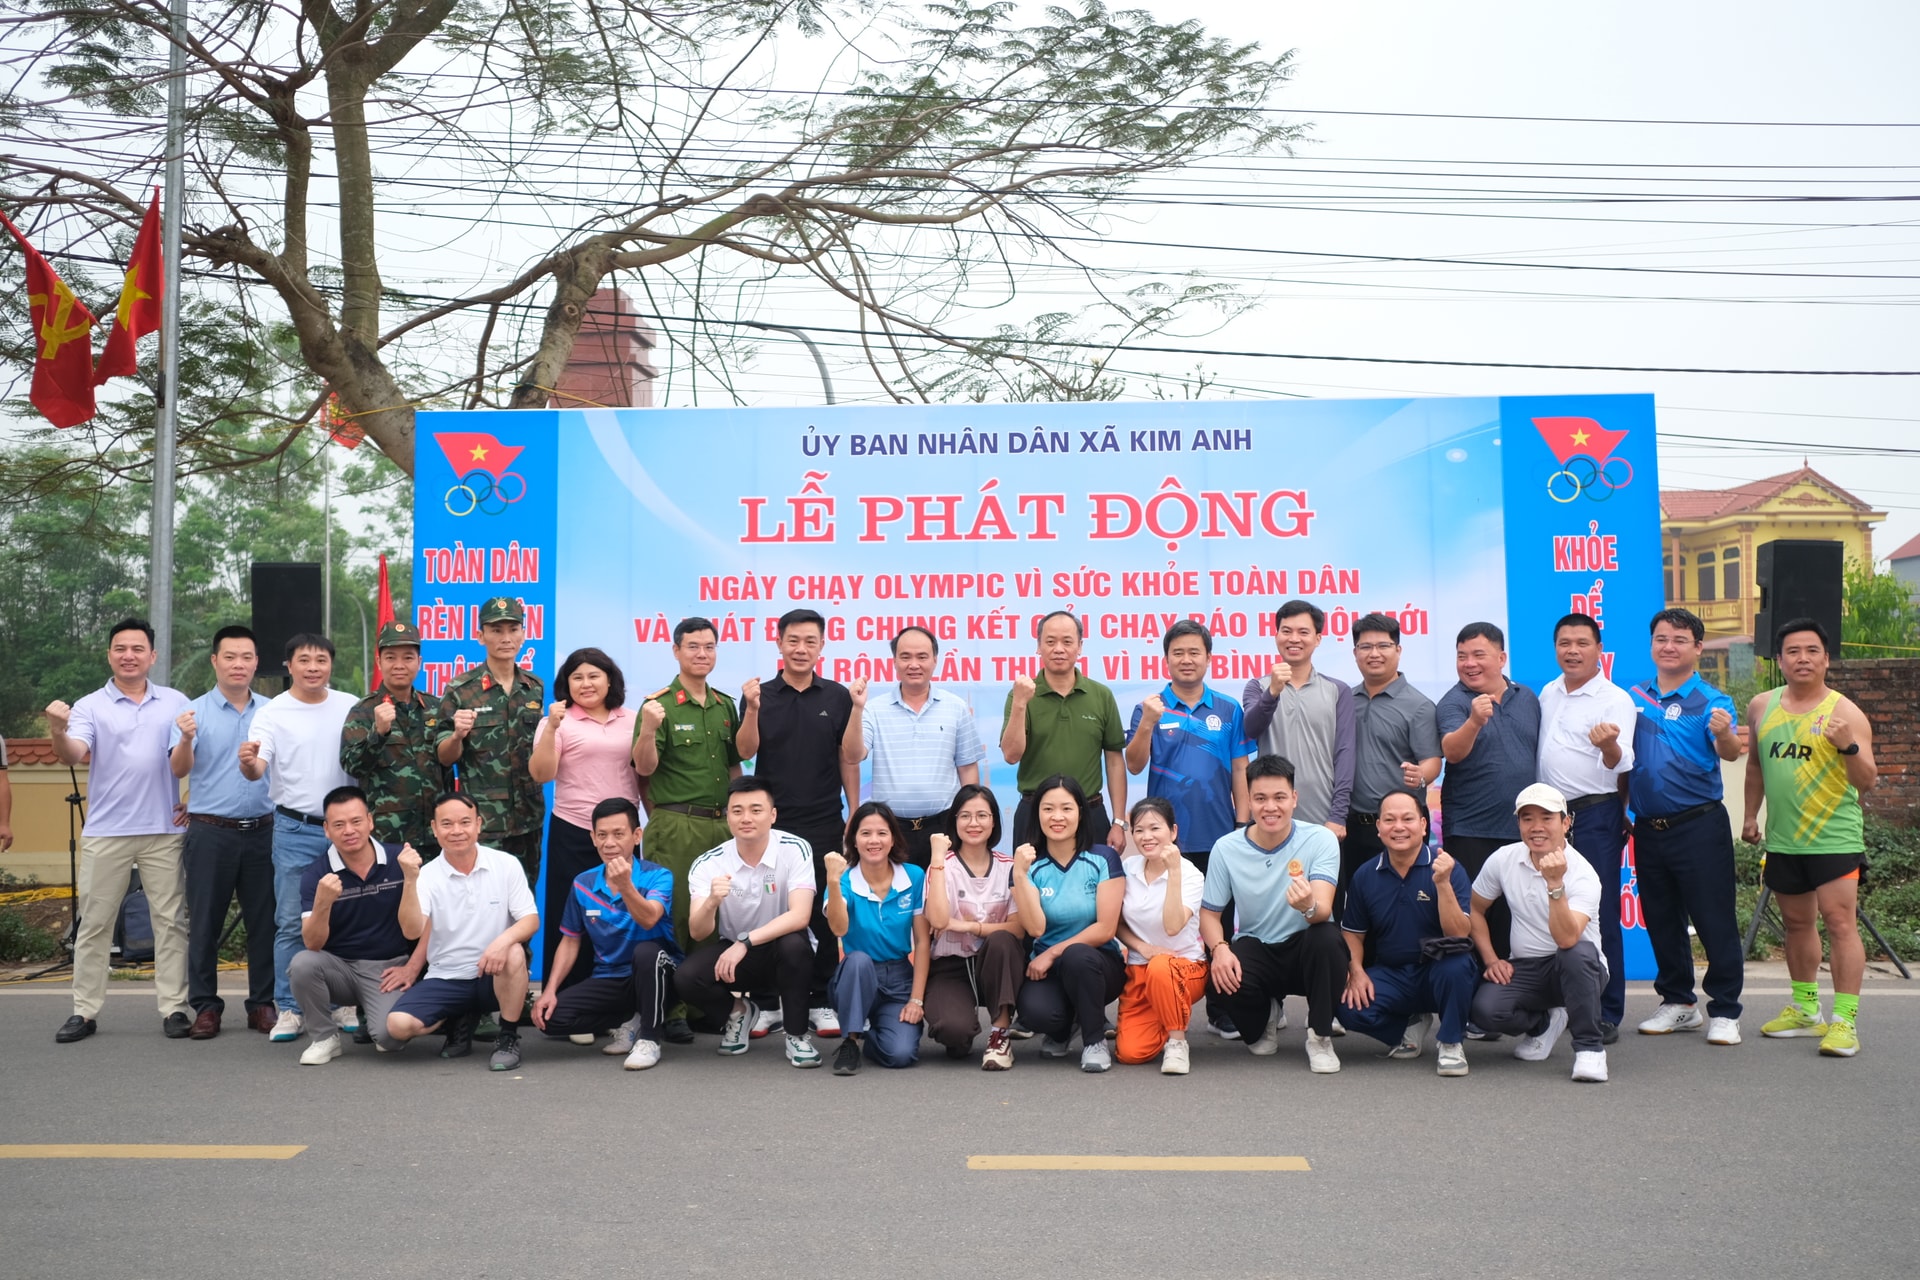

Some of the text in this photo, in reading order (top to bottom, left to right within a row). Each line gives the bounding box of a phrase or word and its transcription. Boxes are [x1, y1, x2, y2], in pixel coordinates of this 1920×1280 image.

[803, 425, 1252, 456] ỦY BAN NHÂN DÂN XÃ KIM ANH
[741, 472, 1315, 551] LỄ PHÁT ĐỘNG
[425, 542, 538, 583] TOÀN DÂN
[1554, 521, 1617, 570] KHỎE
[700, 561, 1360, 605] NGÀY CHẠY OLYMPIC VÌ SỨC KHỎE TOÀN DÂN
[418, 599, 463, 639] RÈN
[634, 613, 671, 642] VÀ
[967, 606, 1020, 639] KẾT
[1103, 651, 1130, 681] VÌ
[1769, 741, 1812, 762] KAR
